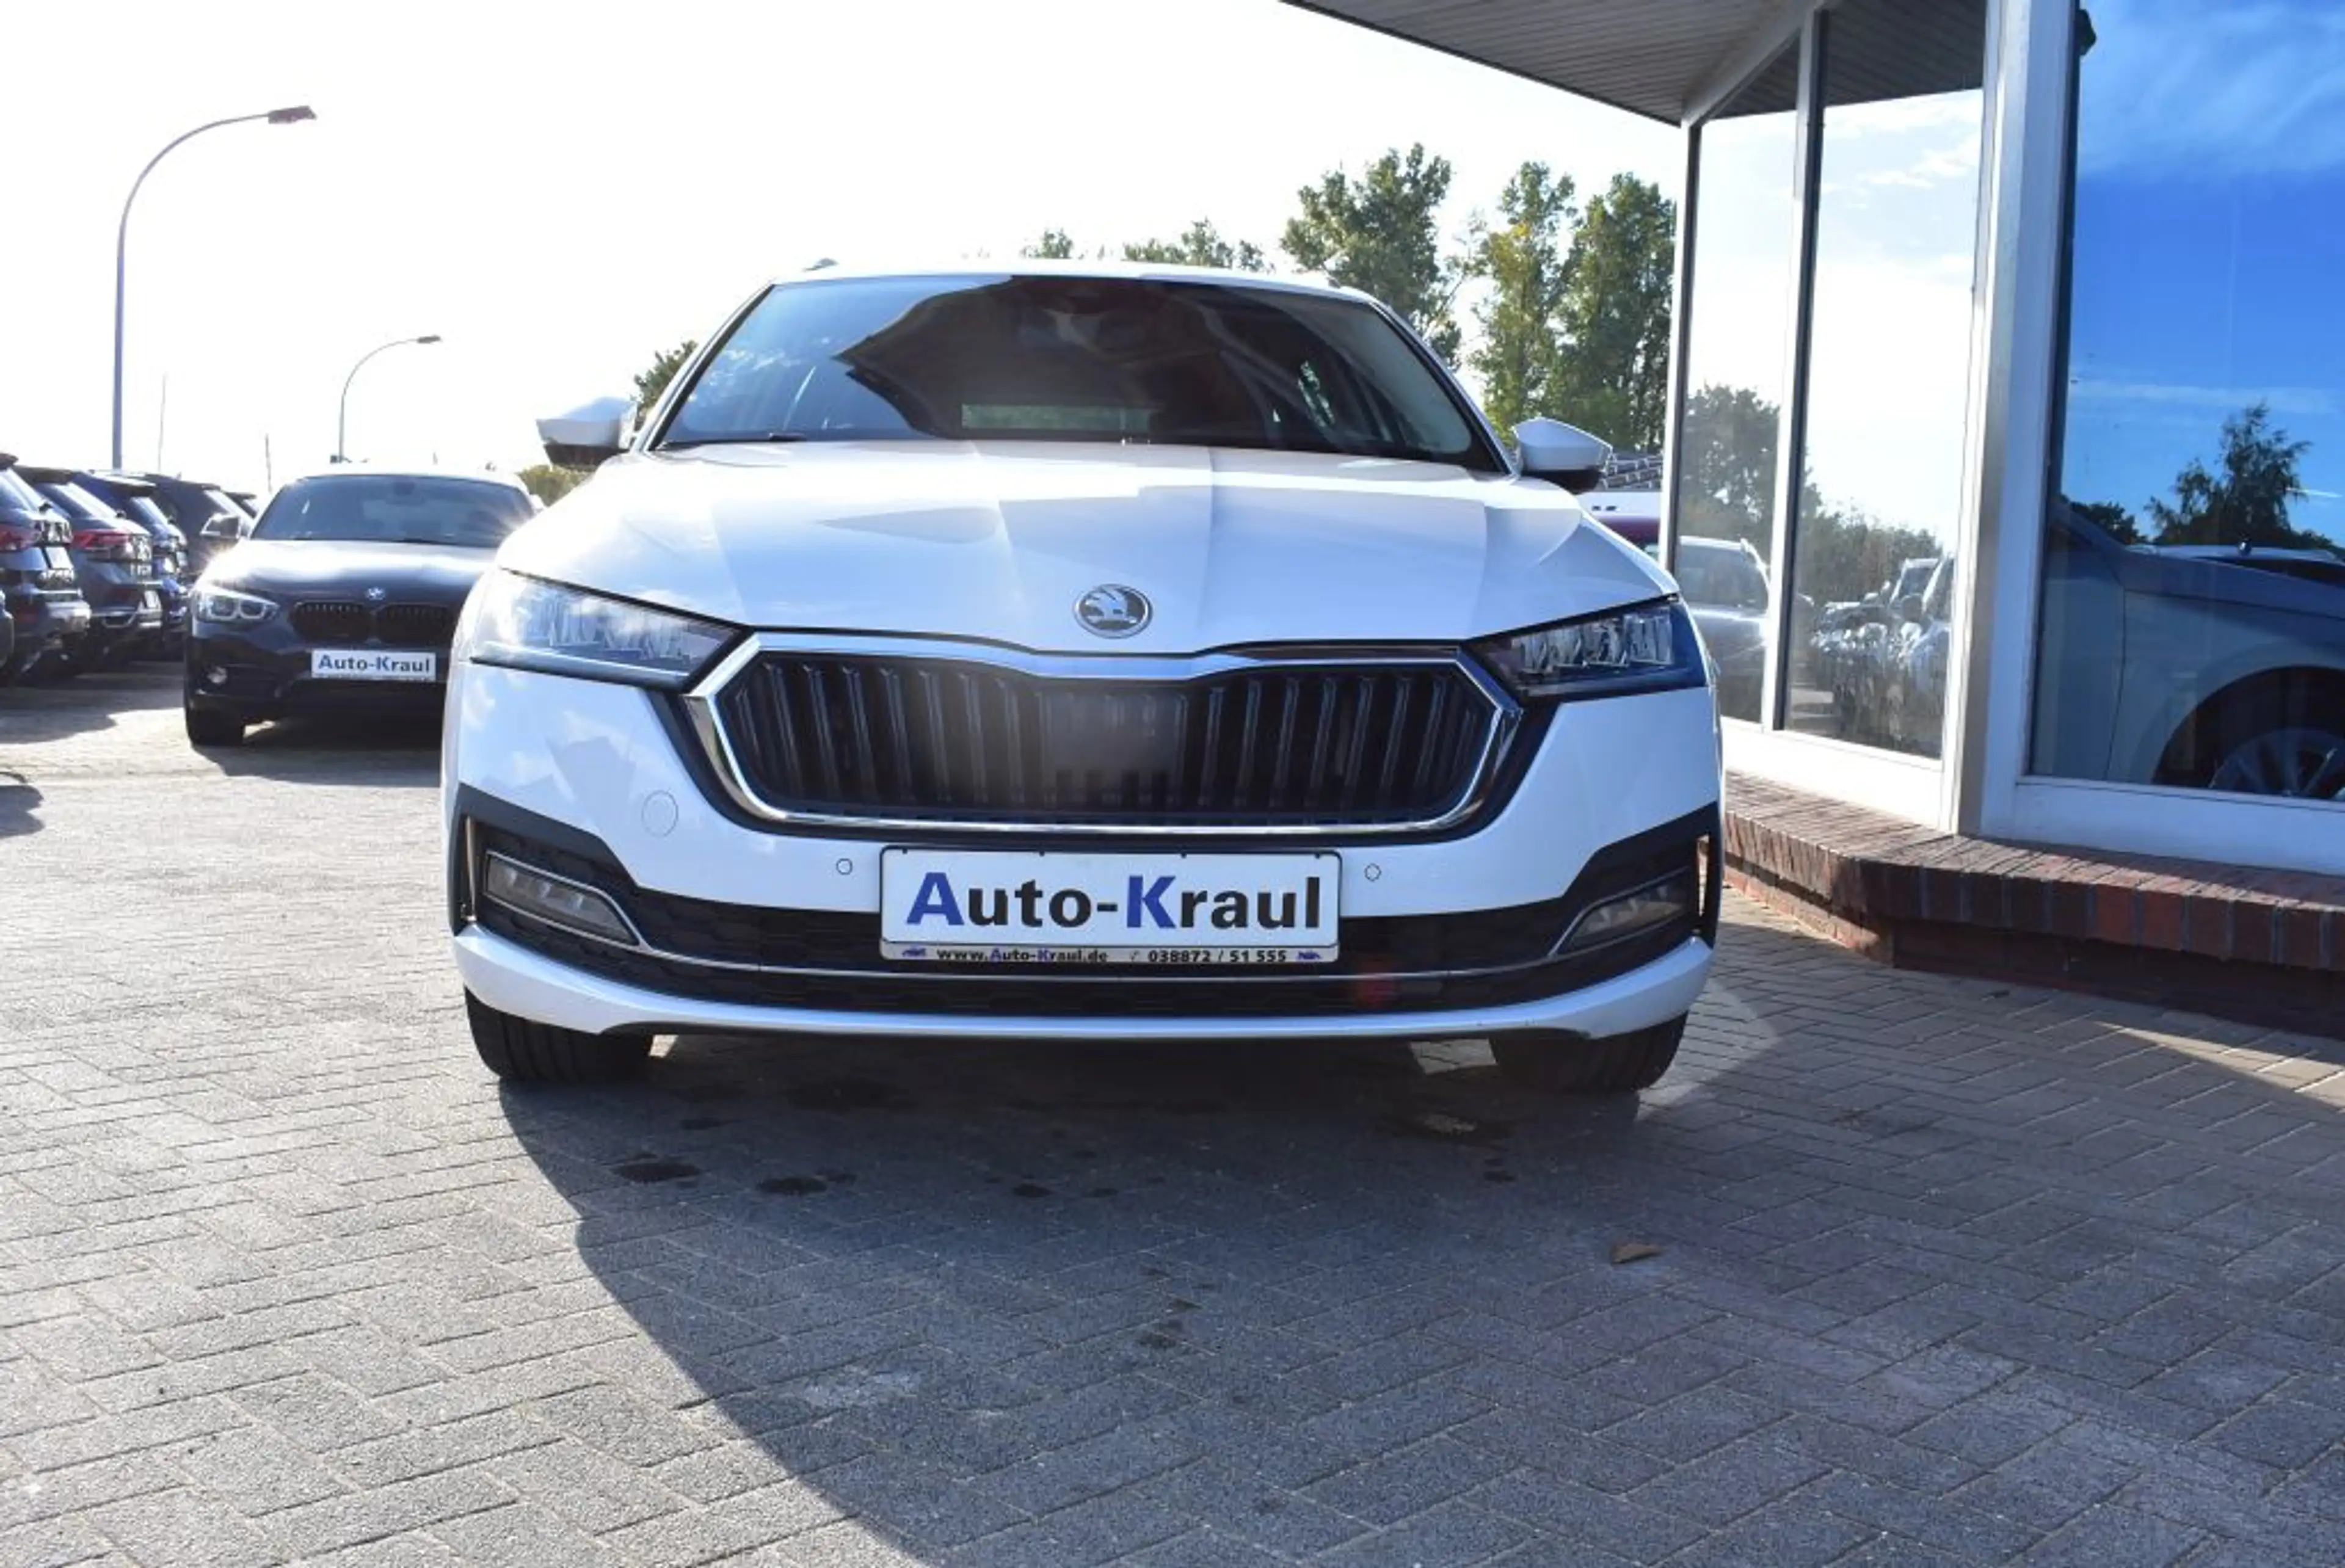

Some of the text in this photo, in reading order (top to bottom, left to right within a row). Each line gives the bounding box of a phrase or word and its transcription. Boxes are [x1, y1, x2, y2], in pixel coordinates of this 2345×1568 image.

[318, 655, 430, 671] Auto-Kraul
[906, 871, 1320, 929] Auto-Kraul
[936, 948, 1108, 962] www.Auto-Kraul.de
[1147, 949, 1211, 962] 038872
[1229, 950, 1250, 962] 51
[1257, 950, 1287, 963] 555
